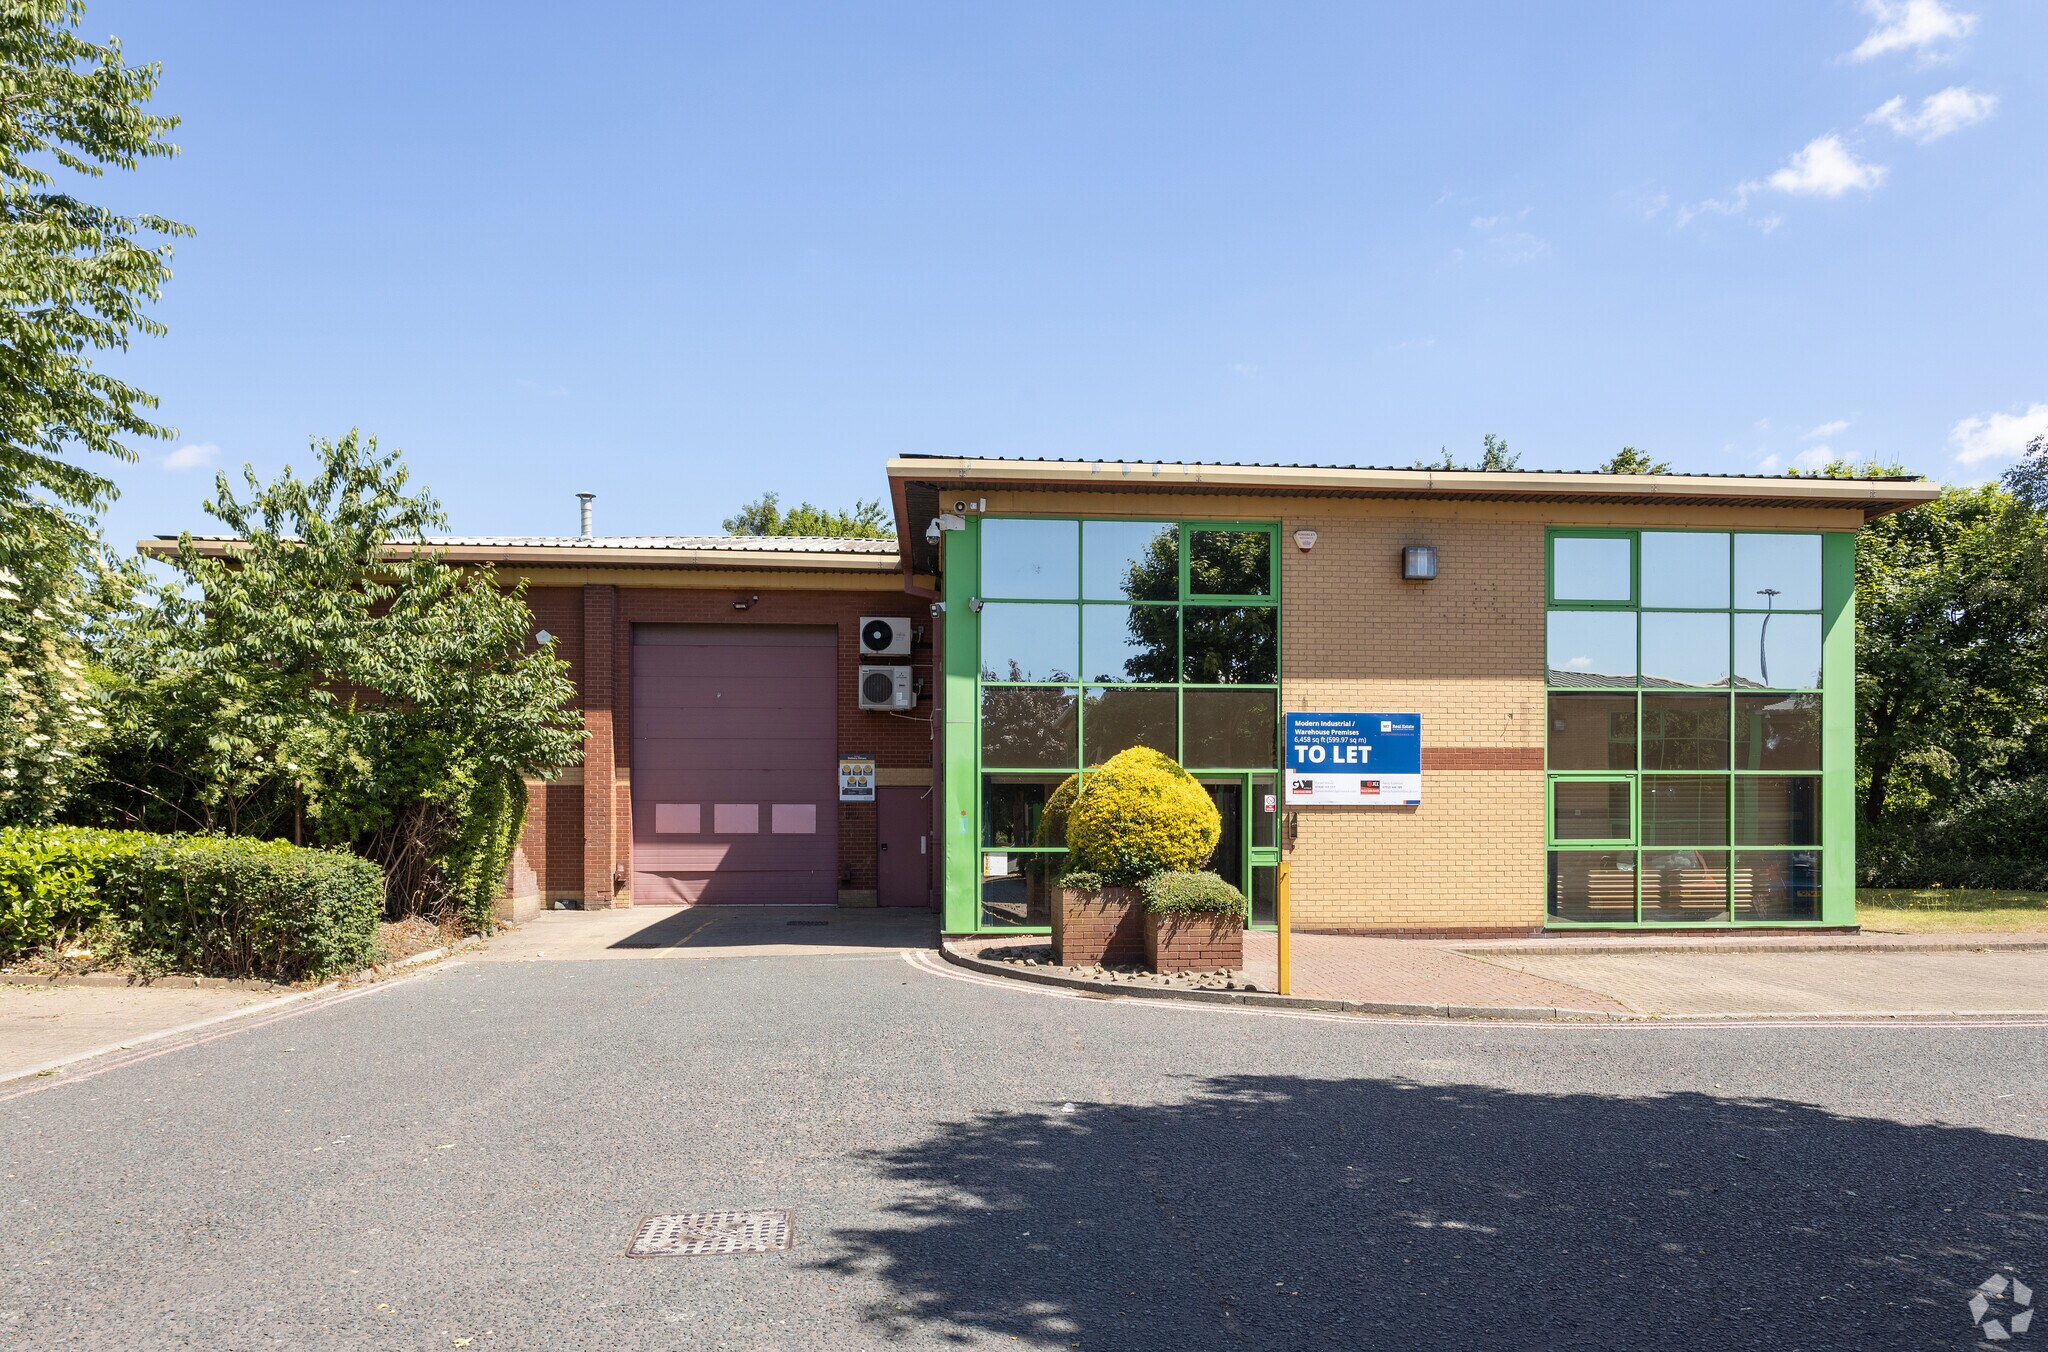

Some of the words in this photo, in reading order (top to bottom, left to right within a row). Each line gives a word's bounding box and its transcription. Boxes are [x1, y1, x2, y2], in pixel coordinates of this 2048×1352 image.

[1326, 736, 1349, 744] (599.97
[1294, 745, 1326, 763] TO
[1333, 745, 1371, 763] LET
